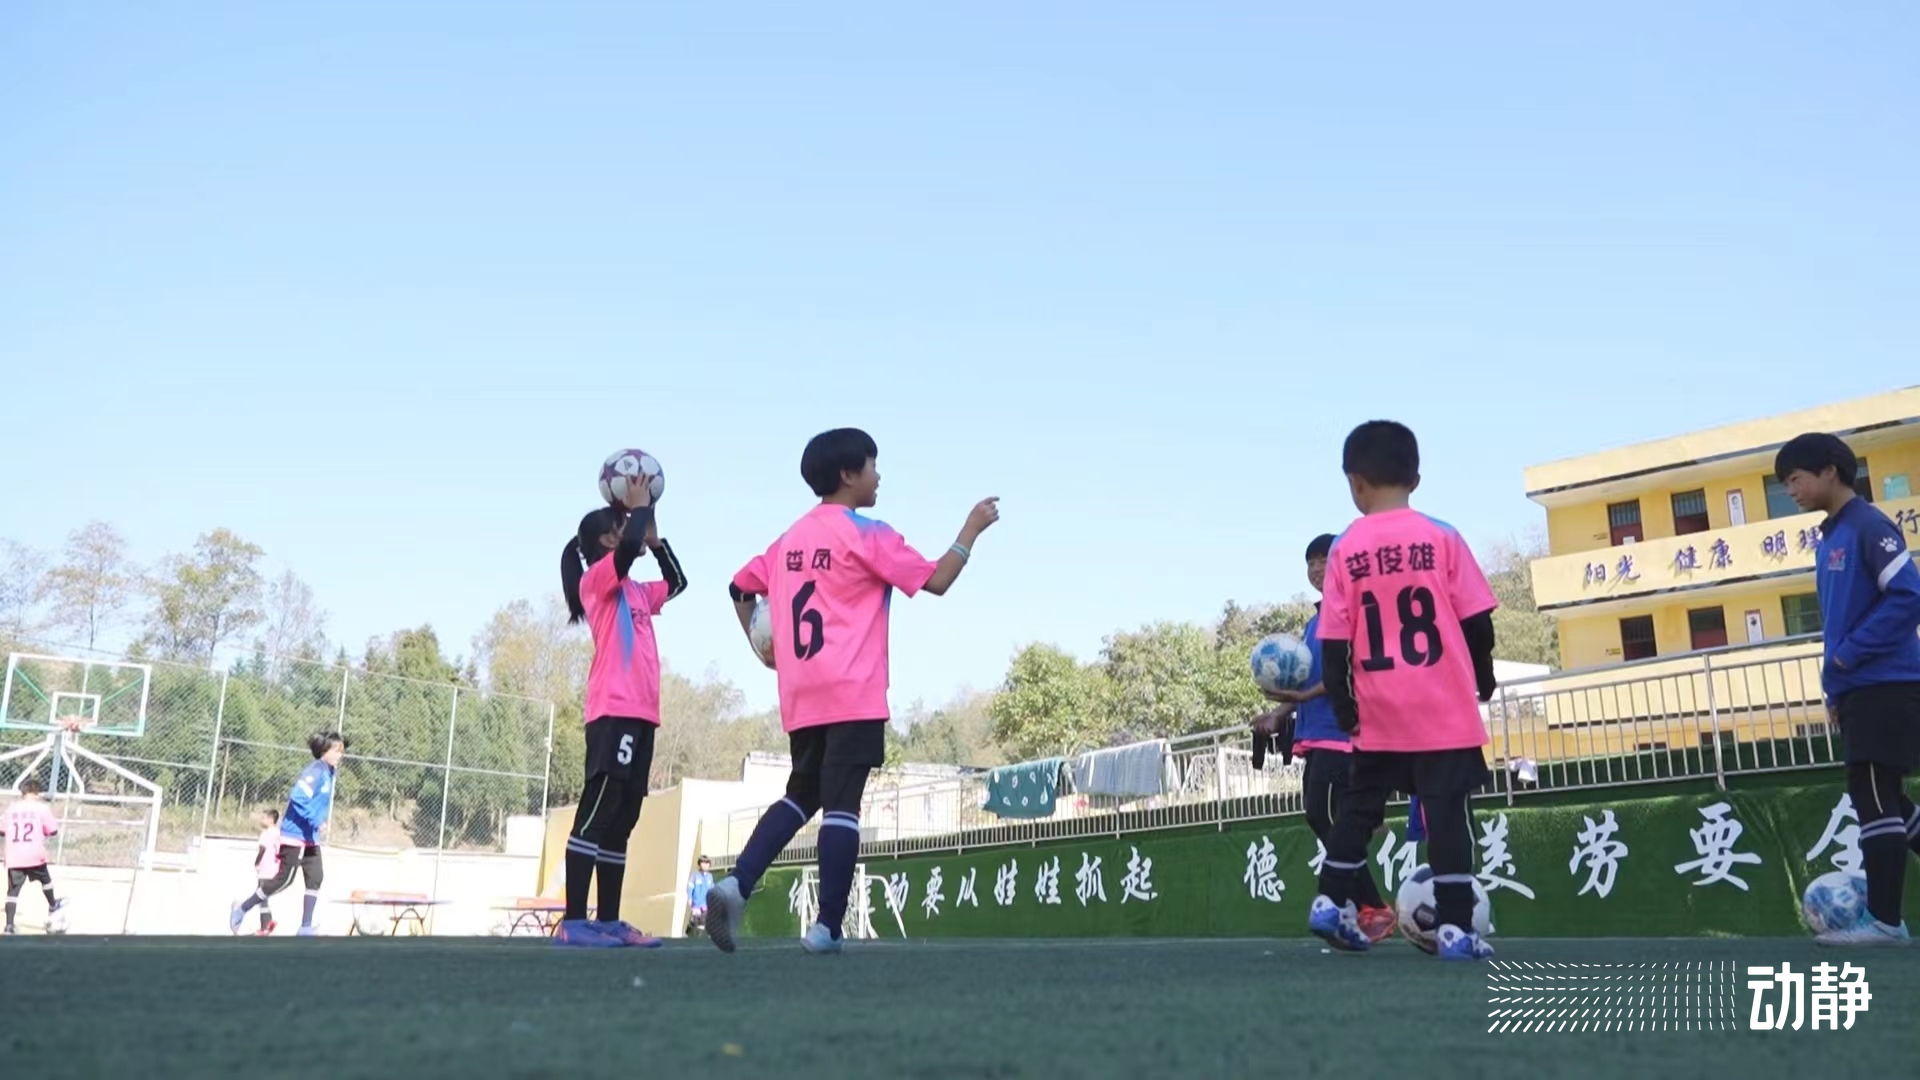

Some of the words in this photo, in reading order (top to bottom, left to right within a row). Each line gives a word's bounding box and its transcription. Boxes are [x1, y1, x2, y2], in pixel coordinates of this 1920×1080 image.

[1585, 554, 1641, 586] 阳光
[1674, 538, 1733, 571] 健康
[792, 580, 824, 661] 6
[1360, 585, 1443, 672] 18
[617, 733, 633, 765] 5
[12, 822, 34, 842] 12
[1243, 792, 1864, 902] 德体美劳要全
